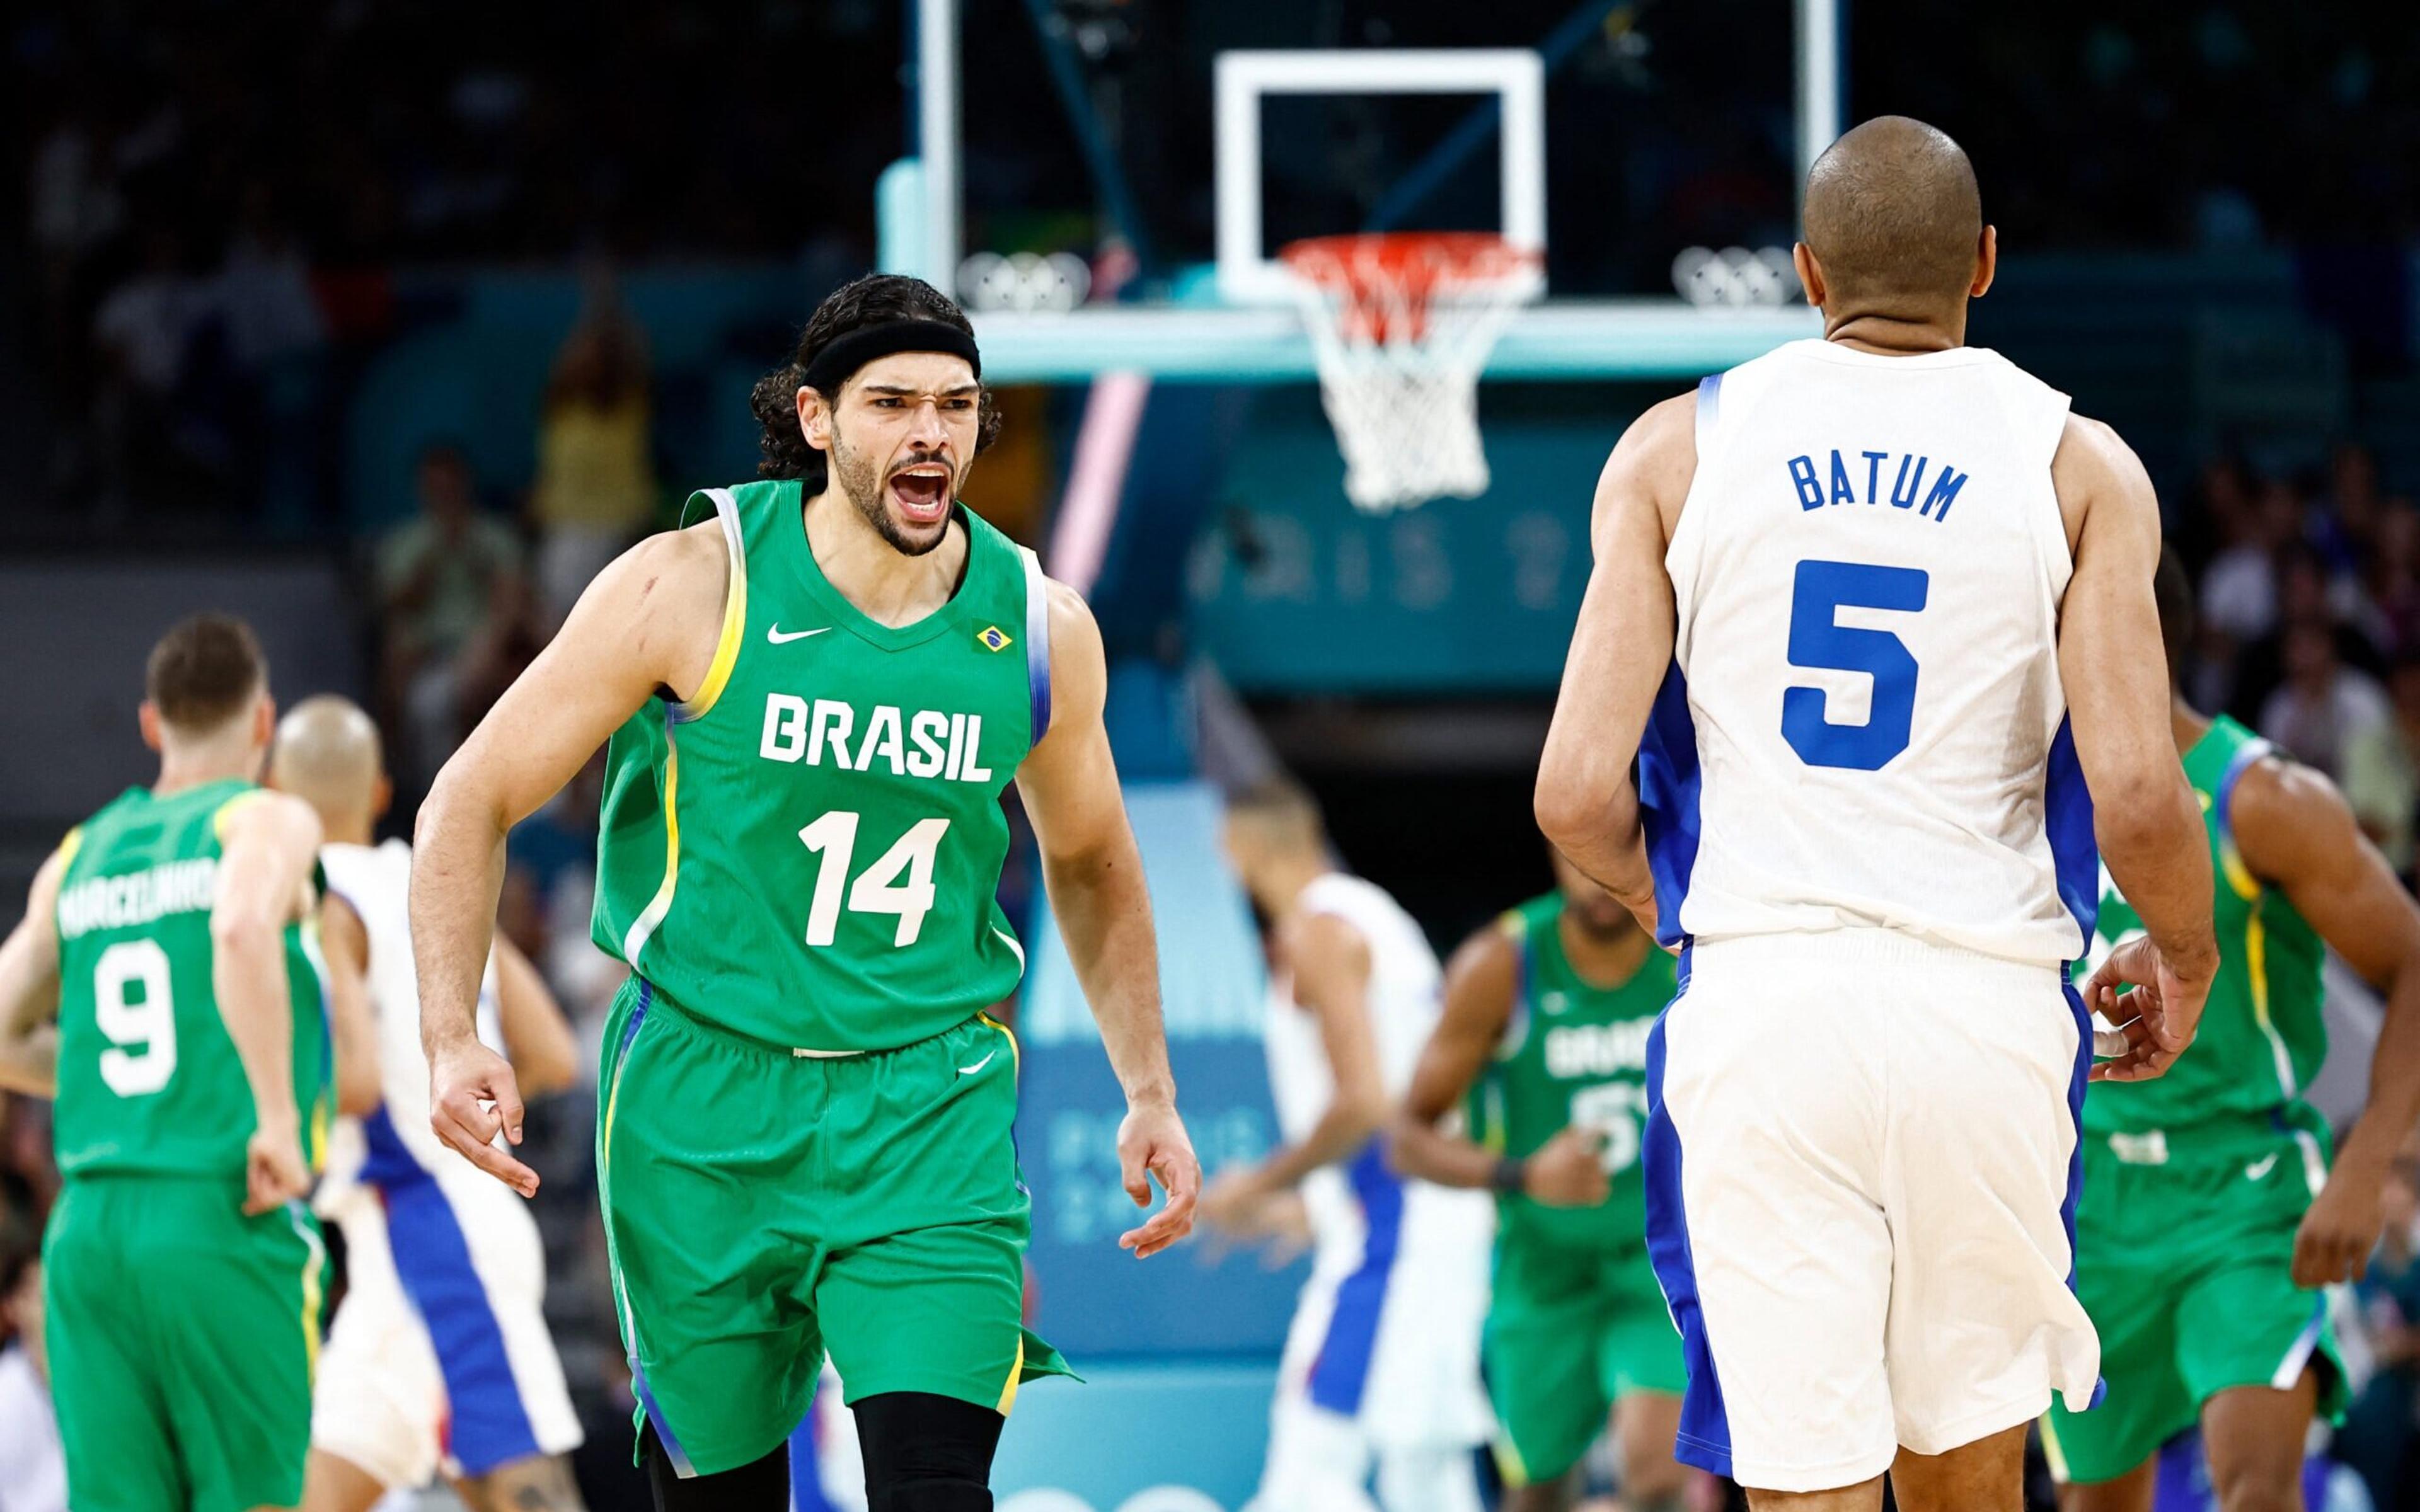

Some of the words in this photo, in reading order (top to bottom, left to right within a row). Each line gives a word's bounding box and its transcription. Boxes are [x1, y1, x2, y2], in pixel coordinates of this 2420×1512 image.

[1787, 449, 1969, 523] BATUM
[1781, 559, 1929, 771] 5
[759, 692, 992, 782] BRASIL
[798, 810, 950, 948] 14
[94, 937, 177, 1098] 9
